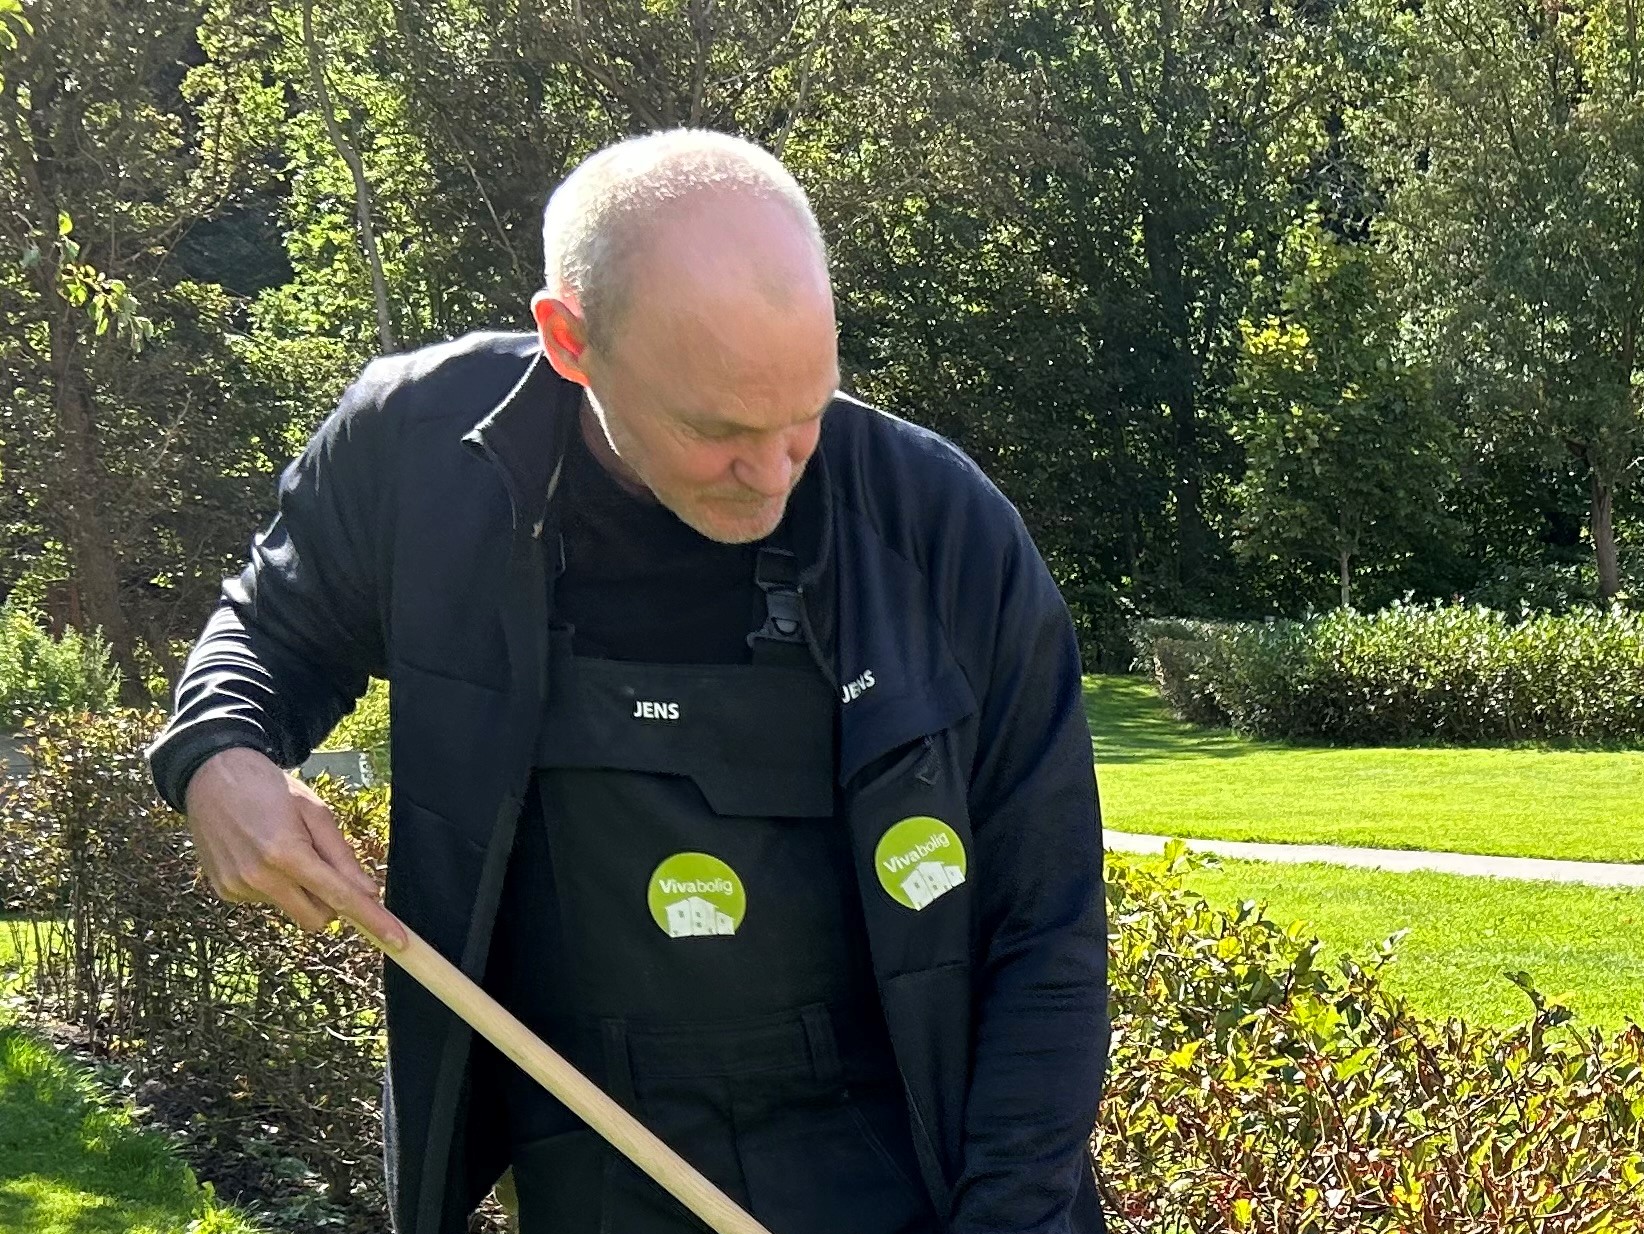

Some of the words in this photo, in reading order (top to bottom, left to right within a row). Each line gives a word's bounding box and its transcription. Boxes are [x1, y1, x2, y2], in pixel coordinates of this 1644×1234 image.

[841, 669, 876, 704] JENS
[633, 701, 680, 719] JENS
[882, 832, 951, 873] Vivabolig
[658, 877, 733, 896] Vivabolig
